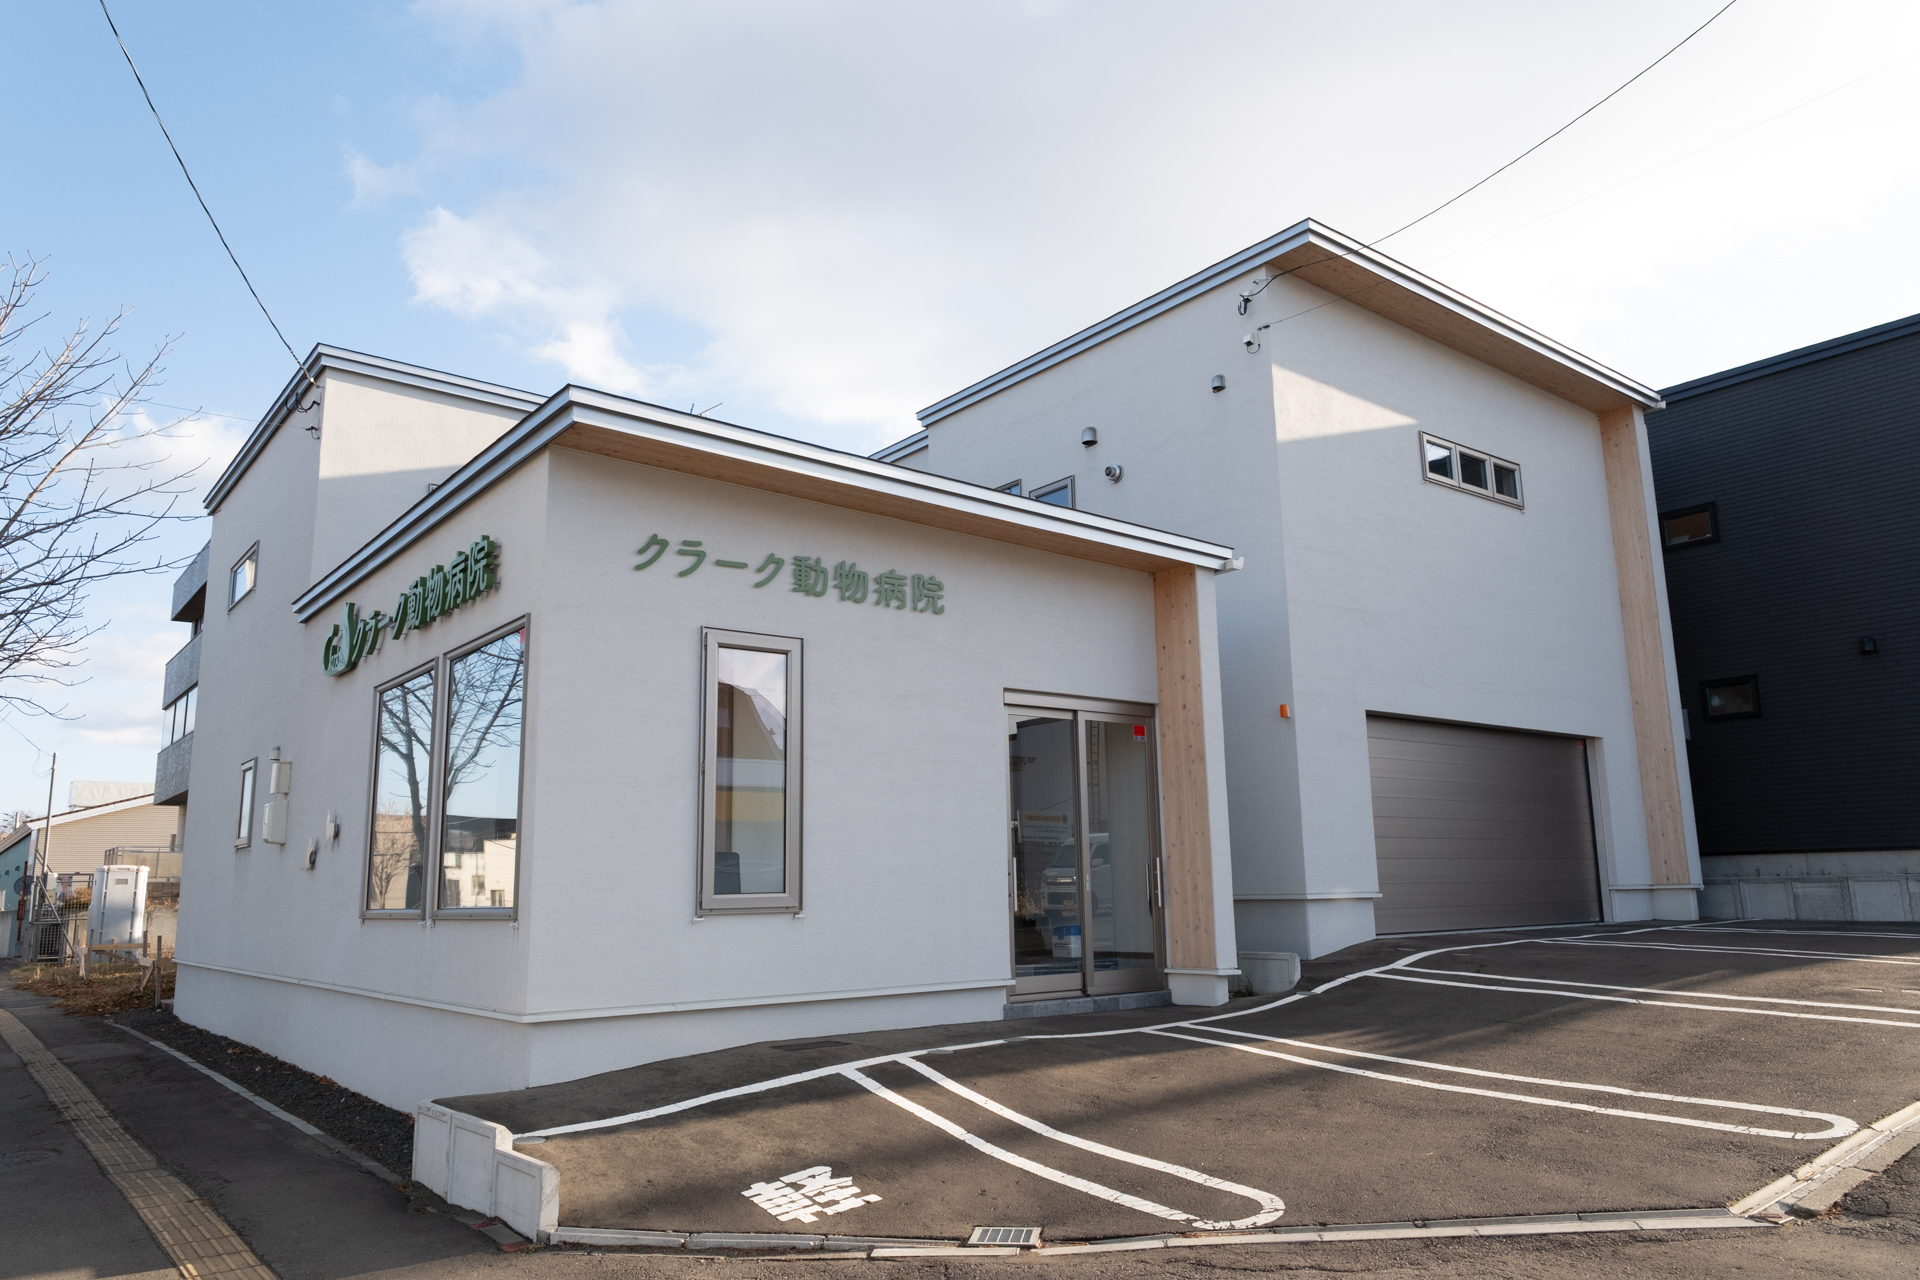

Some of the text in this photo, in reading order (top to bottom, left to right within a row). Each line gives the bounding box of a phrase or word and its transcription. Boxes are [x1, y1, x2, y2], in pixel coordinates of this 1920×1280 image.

[351, 535, 495, 663] クラーク動物病院
[634, 533, 945, 615] クラーク動物病院
[741, 1166, 883, 1223] 軽
